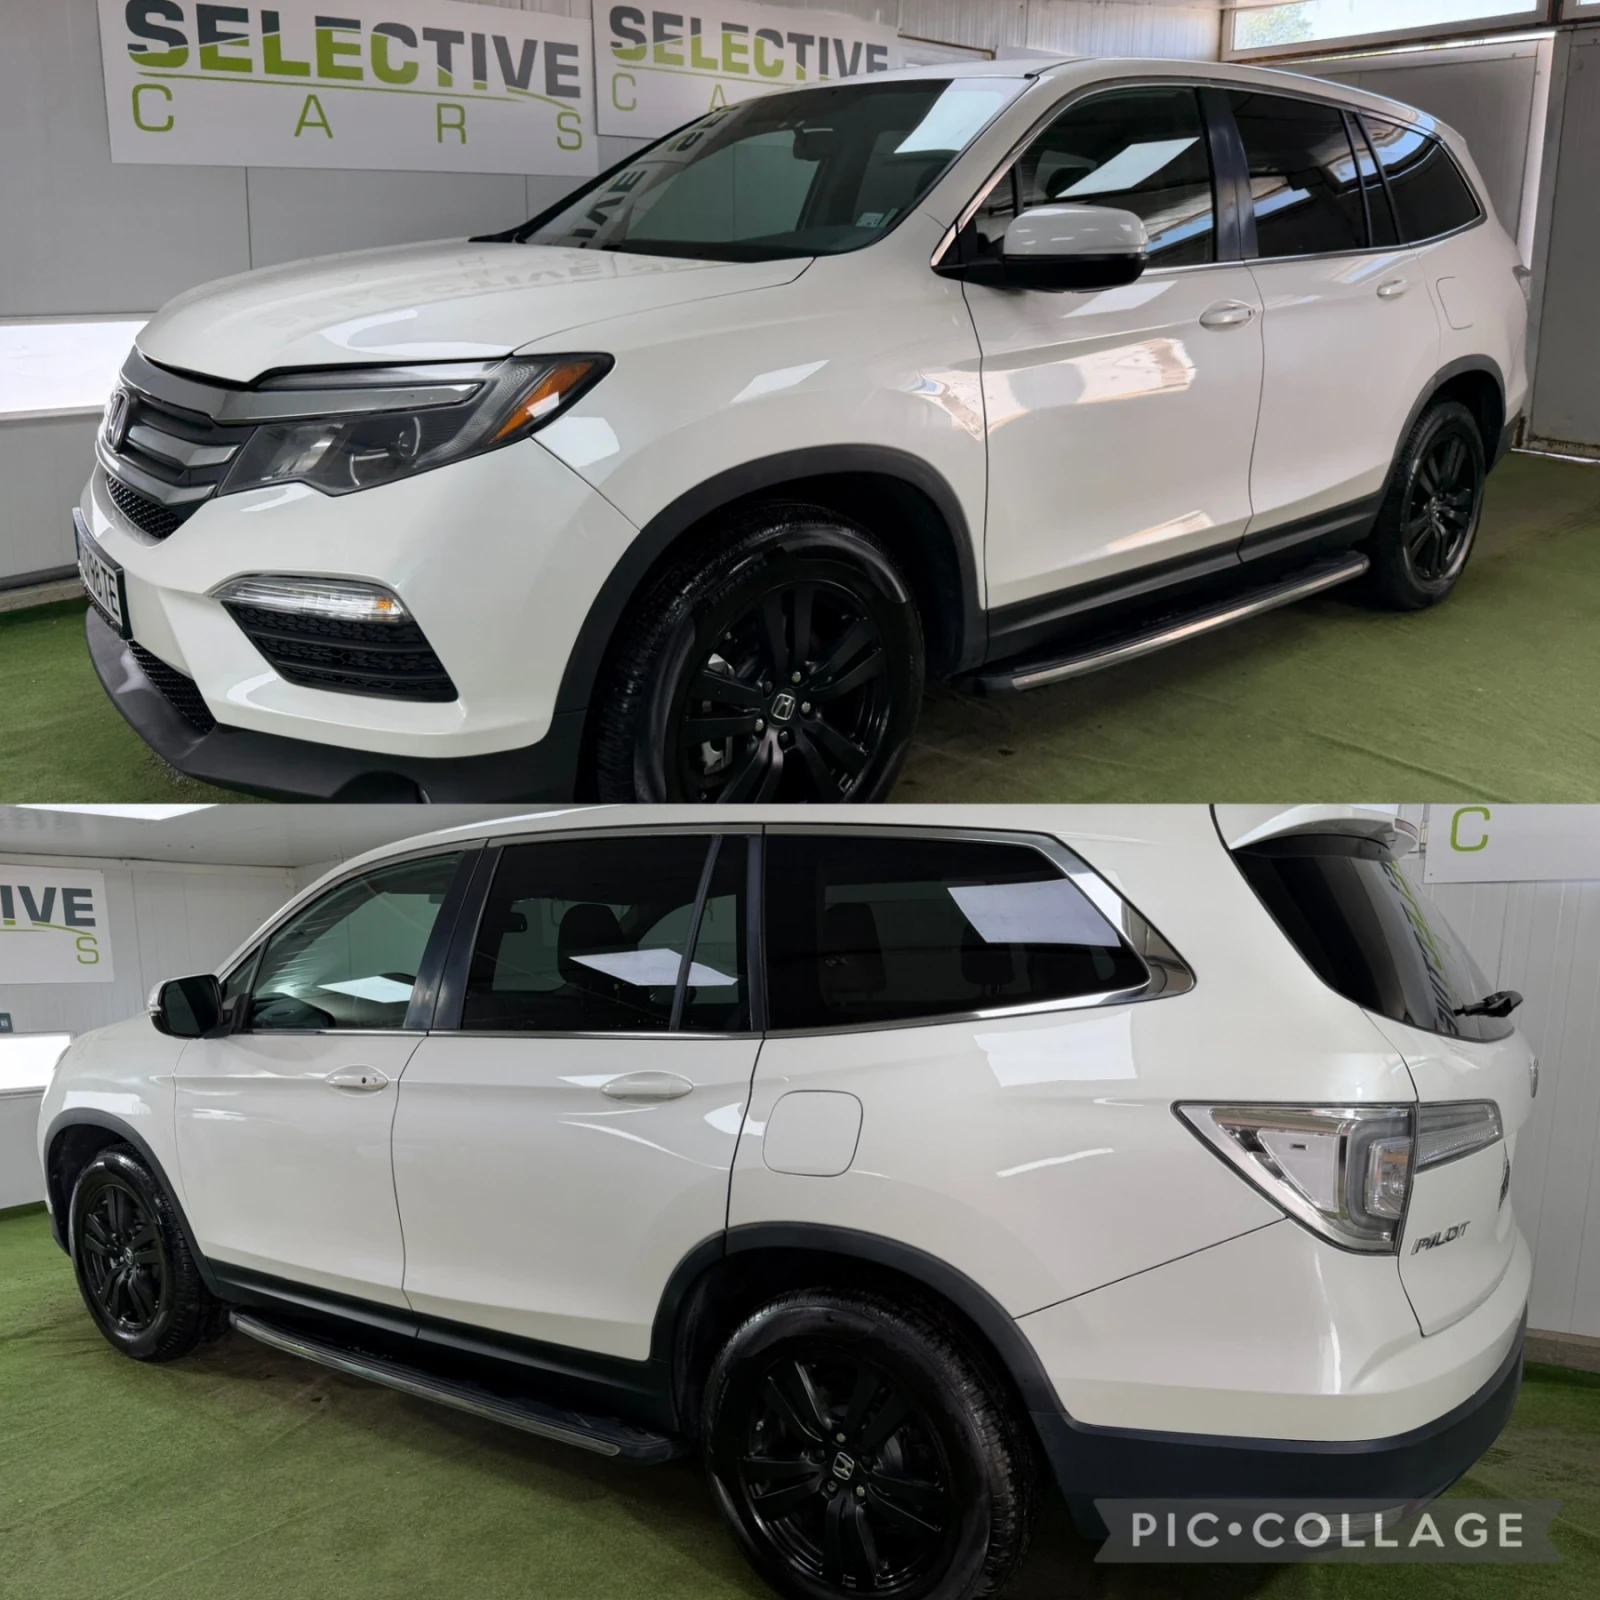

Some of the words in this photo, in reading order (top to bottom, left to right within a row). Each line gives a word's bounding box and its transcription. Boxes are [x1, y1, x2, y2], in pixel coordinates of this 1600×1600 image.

[125, 0, 582, 99] SELECTIVE
[609, 5, 888, 80] SELECTIVE
[131, 83, 583, 151] CARS
[1450, 806, 1491, 852] C
[75, 936, 100, 965] S
[1410, 1221, 1471, 1255] PILOT
